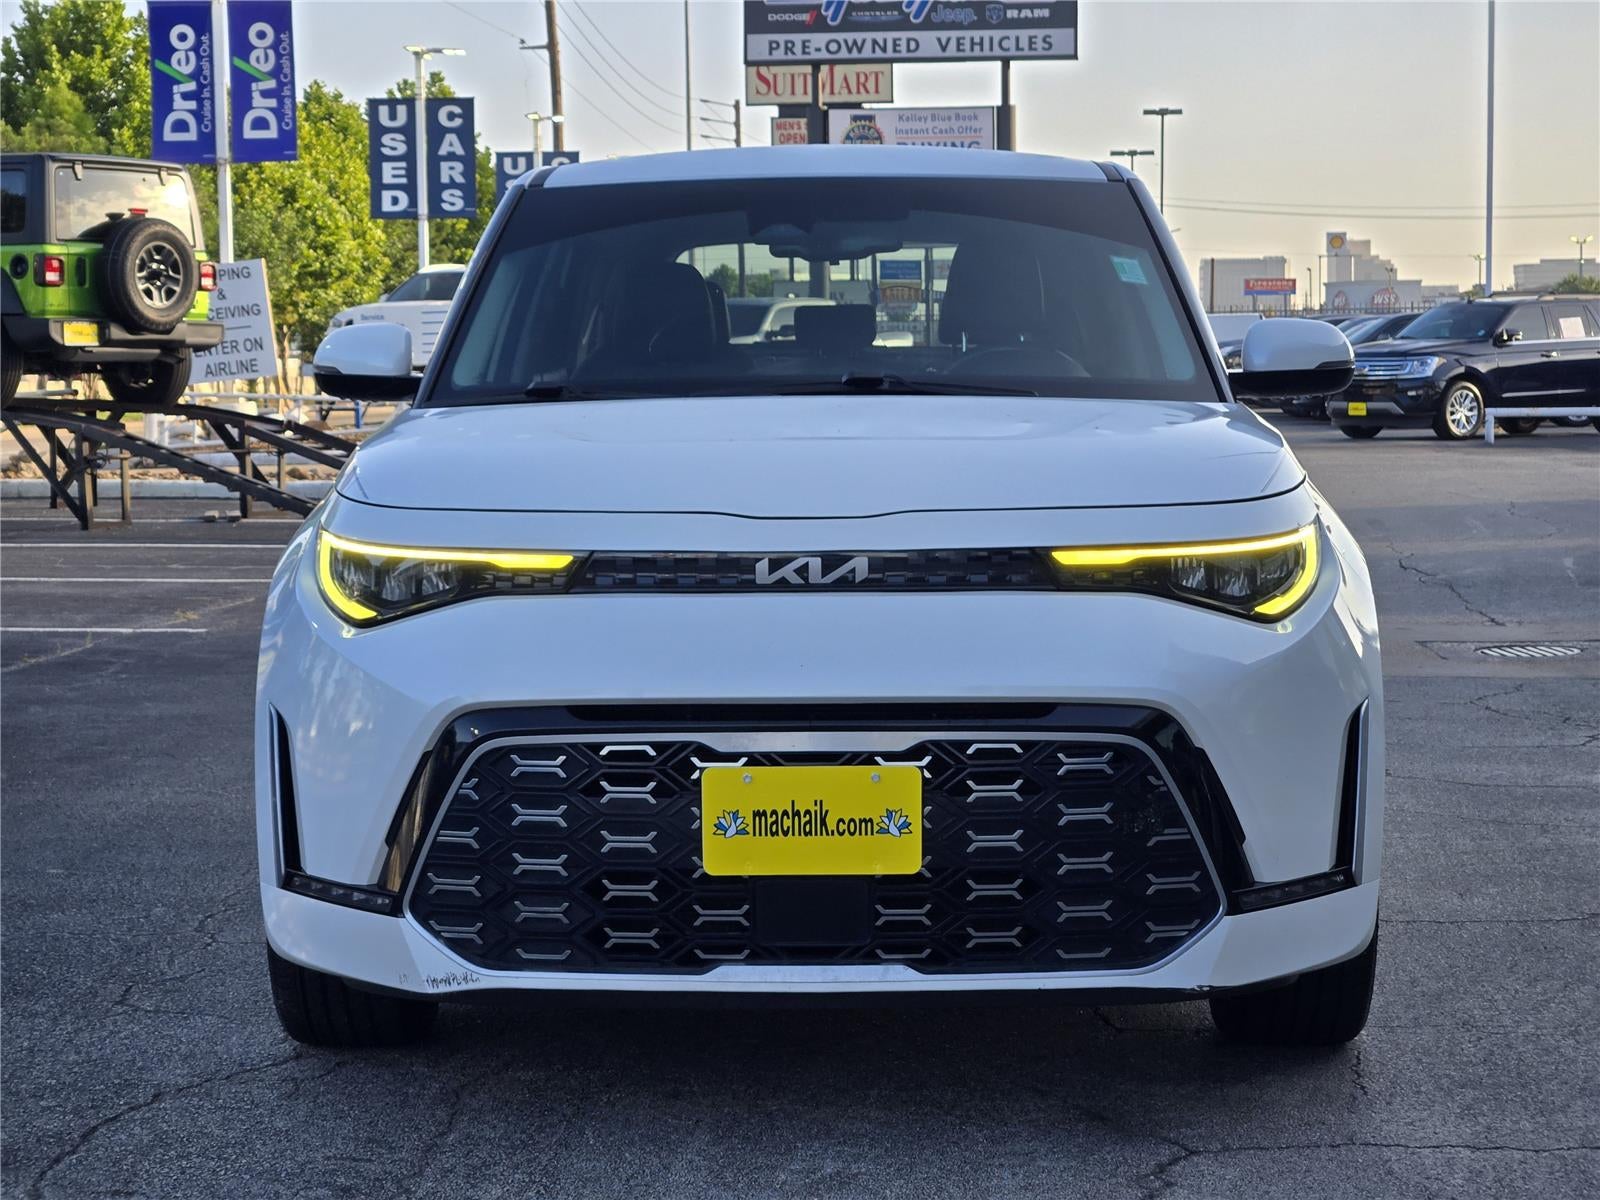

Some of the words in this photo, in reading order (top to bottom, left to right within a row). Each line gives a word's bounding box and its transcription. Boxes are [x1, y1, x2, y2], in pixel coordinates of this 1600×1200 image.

[767, 13, 810, 21] DODGE
[1006, 8, 1050, 19] RAM
[767, 36, 920, 56] PRE-OWNED
[936, 35, 1053, 53] VEHICLES
[200, 58, 211, 84] Cash
[279, 56, 291, 82] Cash
[201, 101, 212, 133] Cruise
[281, 99, 293, 130] Cruise
[898, 113, 928, 124] Kelley
[930, 113, 953, 122] Blue
[955, 112, 978, 121] Book
[778, 133, 806, 145] OPEN
[895, 127, 930, 136] Instant
[931, 126, 955, 135] Cash
[957, 125, 984, 135] Offer
[378, 104, 409, 212] USED
[437, 104, 465, 212] CARS
[218, 266, 251, 281] PING
[217, 288, 227, 301] &
[207, 303, 261, 321] CEIVING
[243, 337, 264, 353] ON
[204, 358, 259, 378] AIRLINE
[755, 556, 869, 585] KIA
[752, 800, 875, 838] machaik.com
